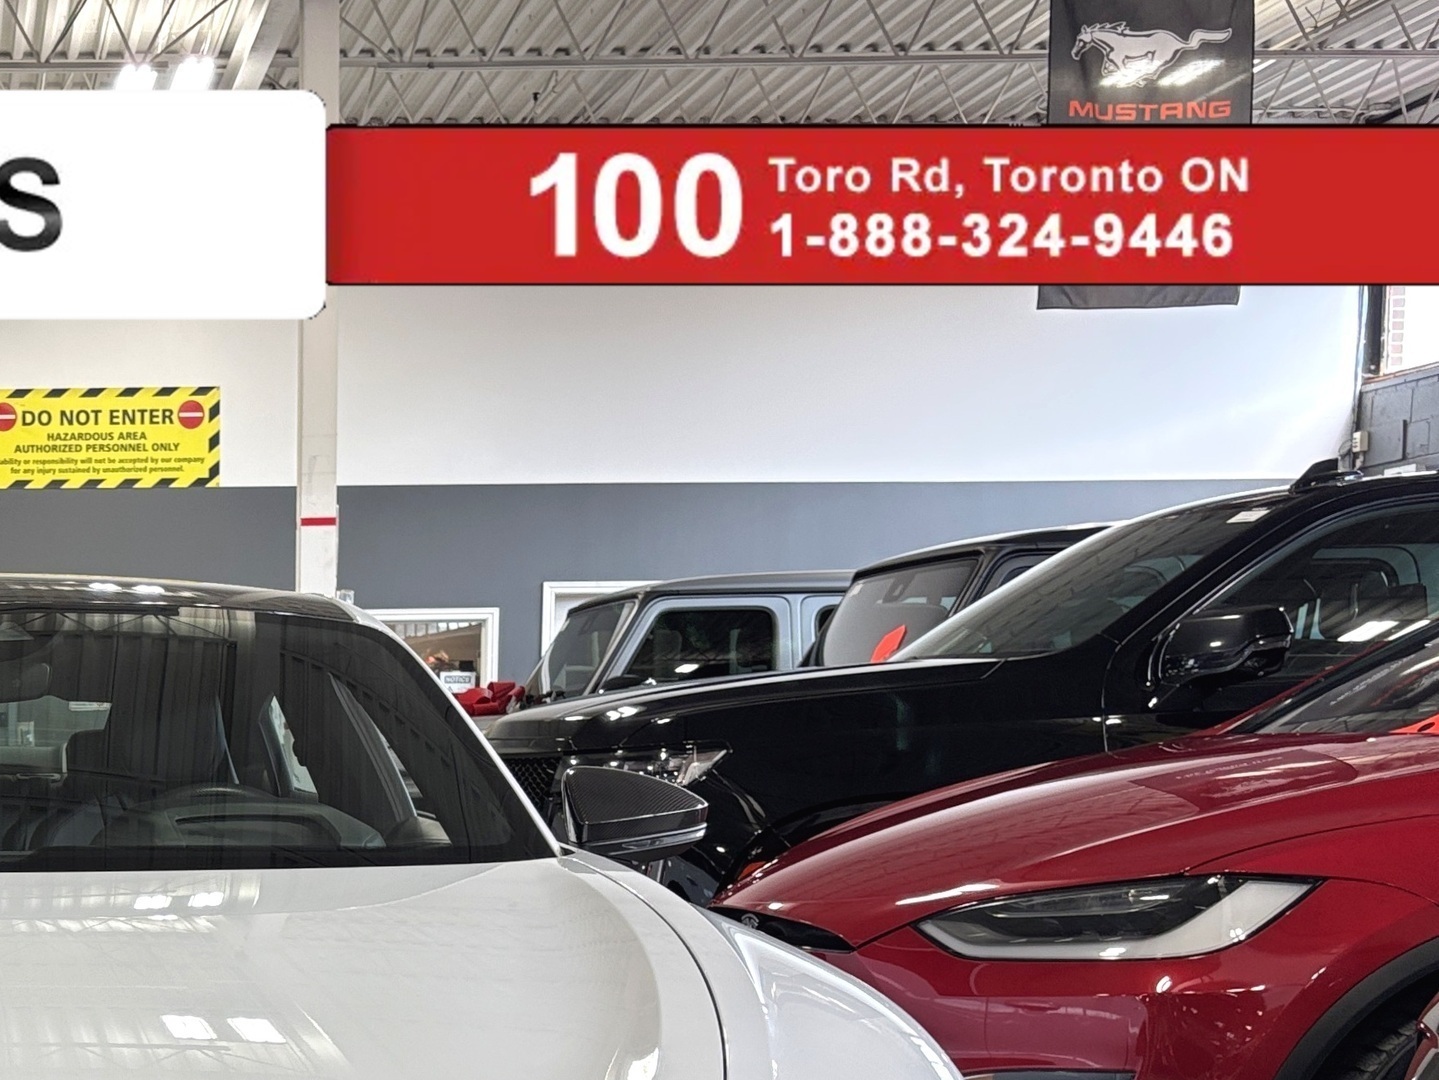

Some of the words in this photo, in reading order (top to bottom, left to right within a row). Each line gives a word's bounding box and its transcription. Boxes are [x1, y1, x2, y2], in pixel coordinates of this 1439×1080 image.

[1068, 99, 1231, 121] MUSTANG
[21, 410, 52, 427] DO
[60, 409, 102, 426] NOT
[109, 408, 175, 426] ENTER
[47, 432, 114, 442] HAZARDOUS
[117, 431, 147, 441] AREA
[14, 444, 83, 454] AUTHORIZED
[85, 443, 148, 453] PERSONNEL
[151, 442, 180, 452] ONLY
[32, 457, 79, 466] responsibility
